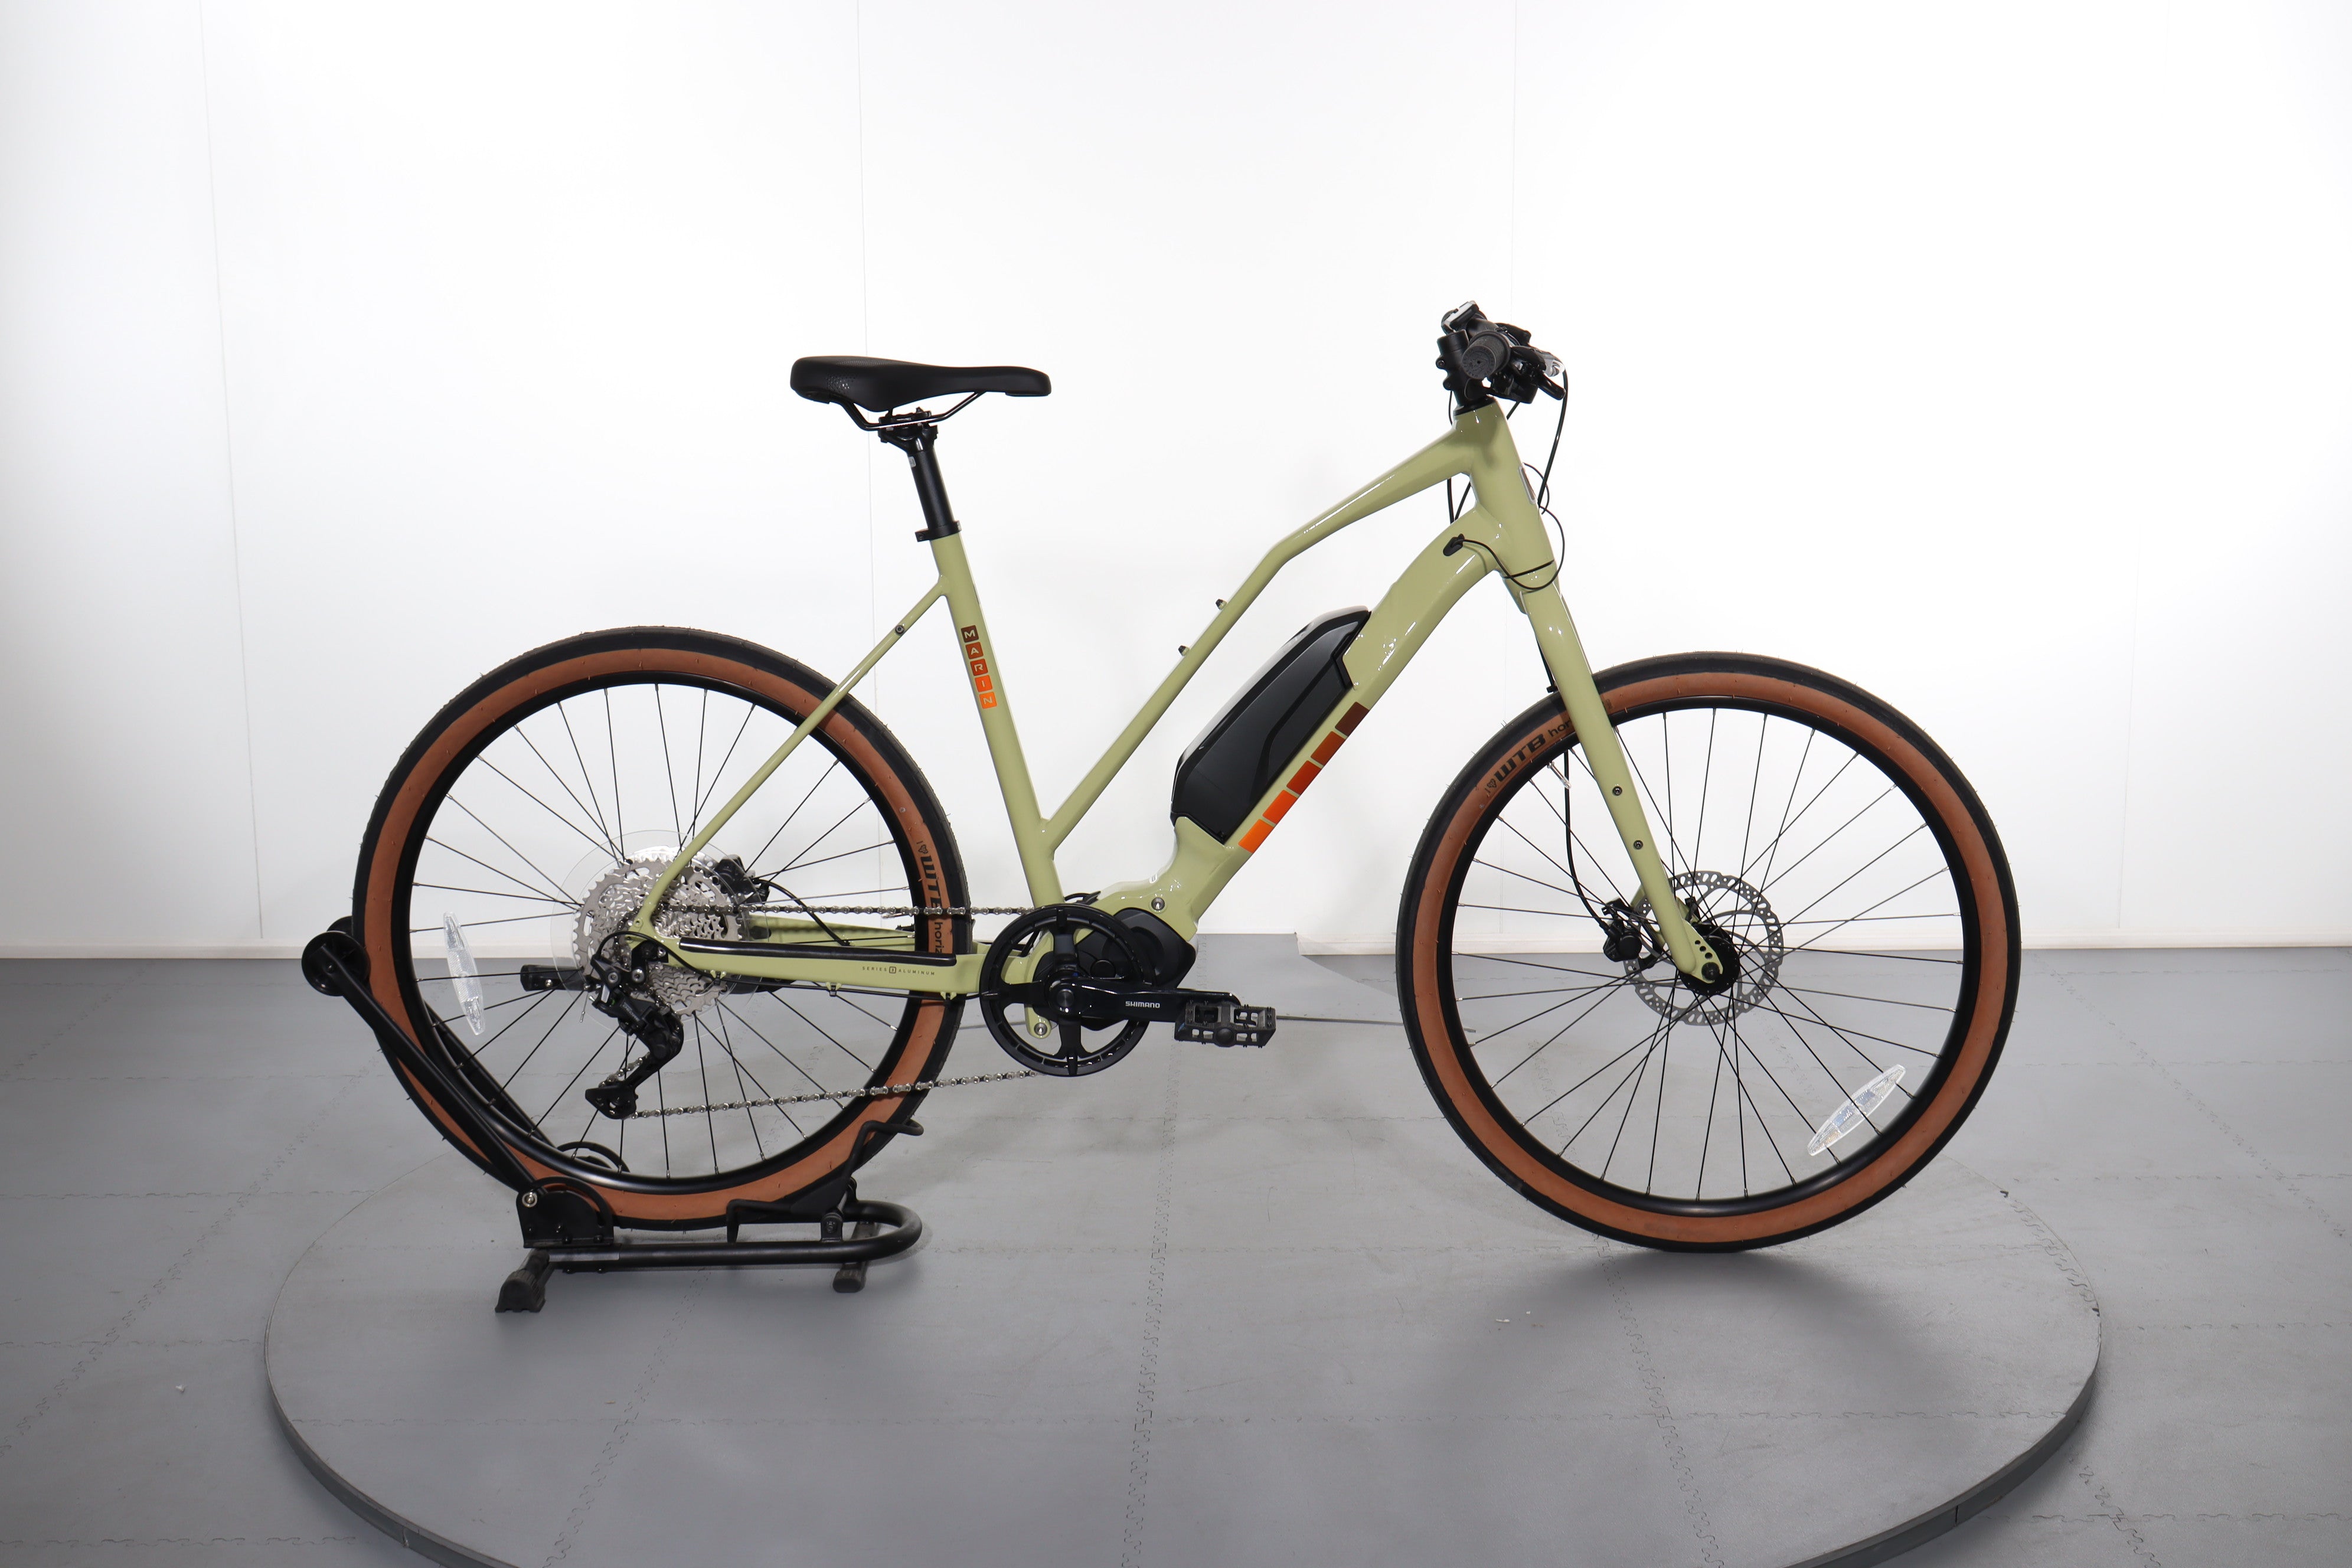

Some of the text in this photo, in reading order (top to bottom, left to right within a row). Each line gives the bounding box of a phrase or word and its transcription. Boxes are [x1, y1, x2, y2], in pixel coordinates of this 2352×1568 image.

[963, 629, 994, 705] MARIN
[1494, 734, 1546, 782] WTB
[1547, 718, 1571, 737] hor
